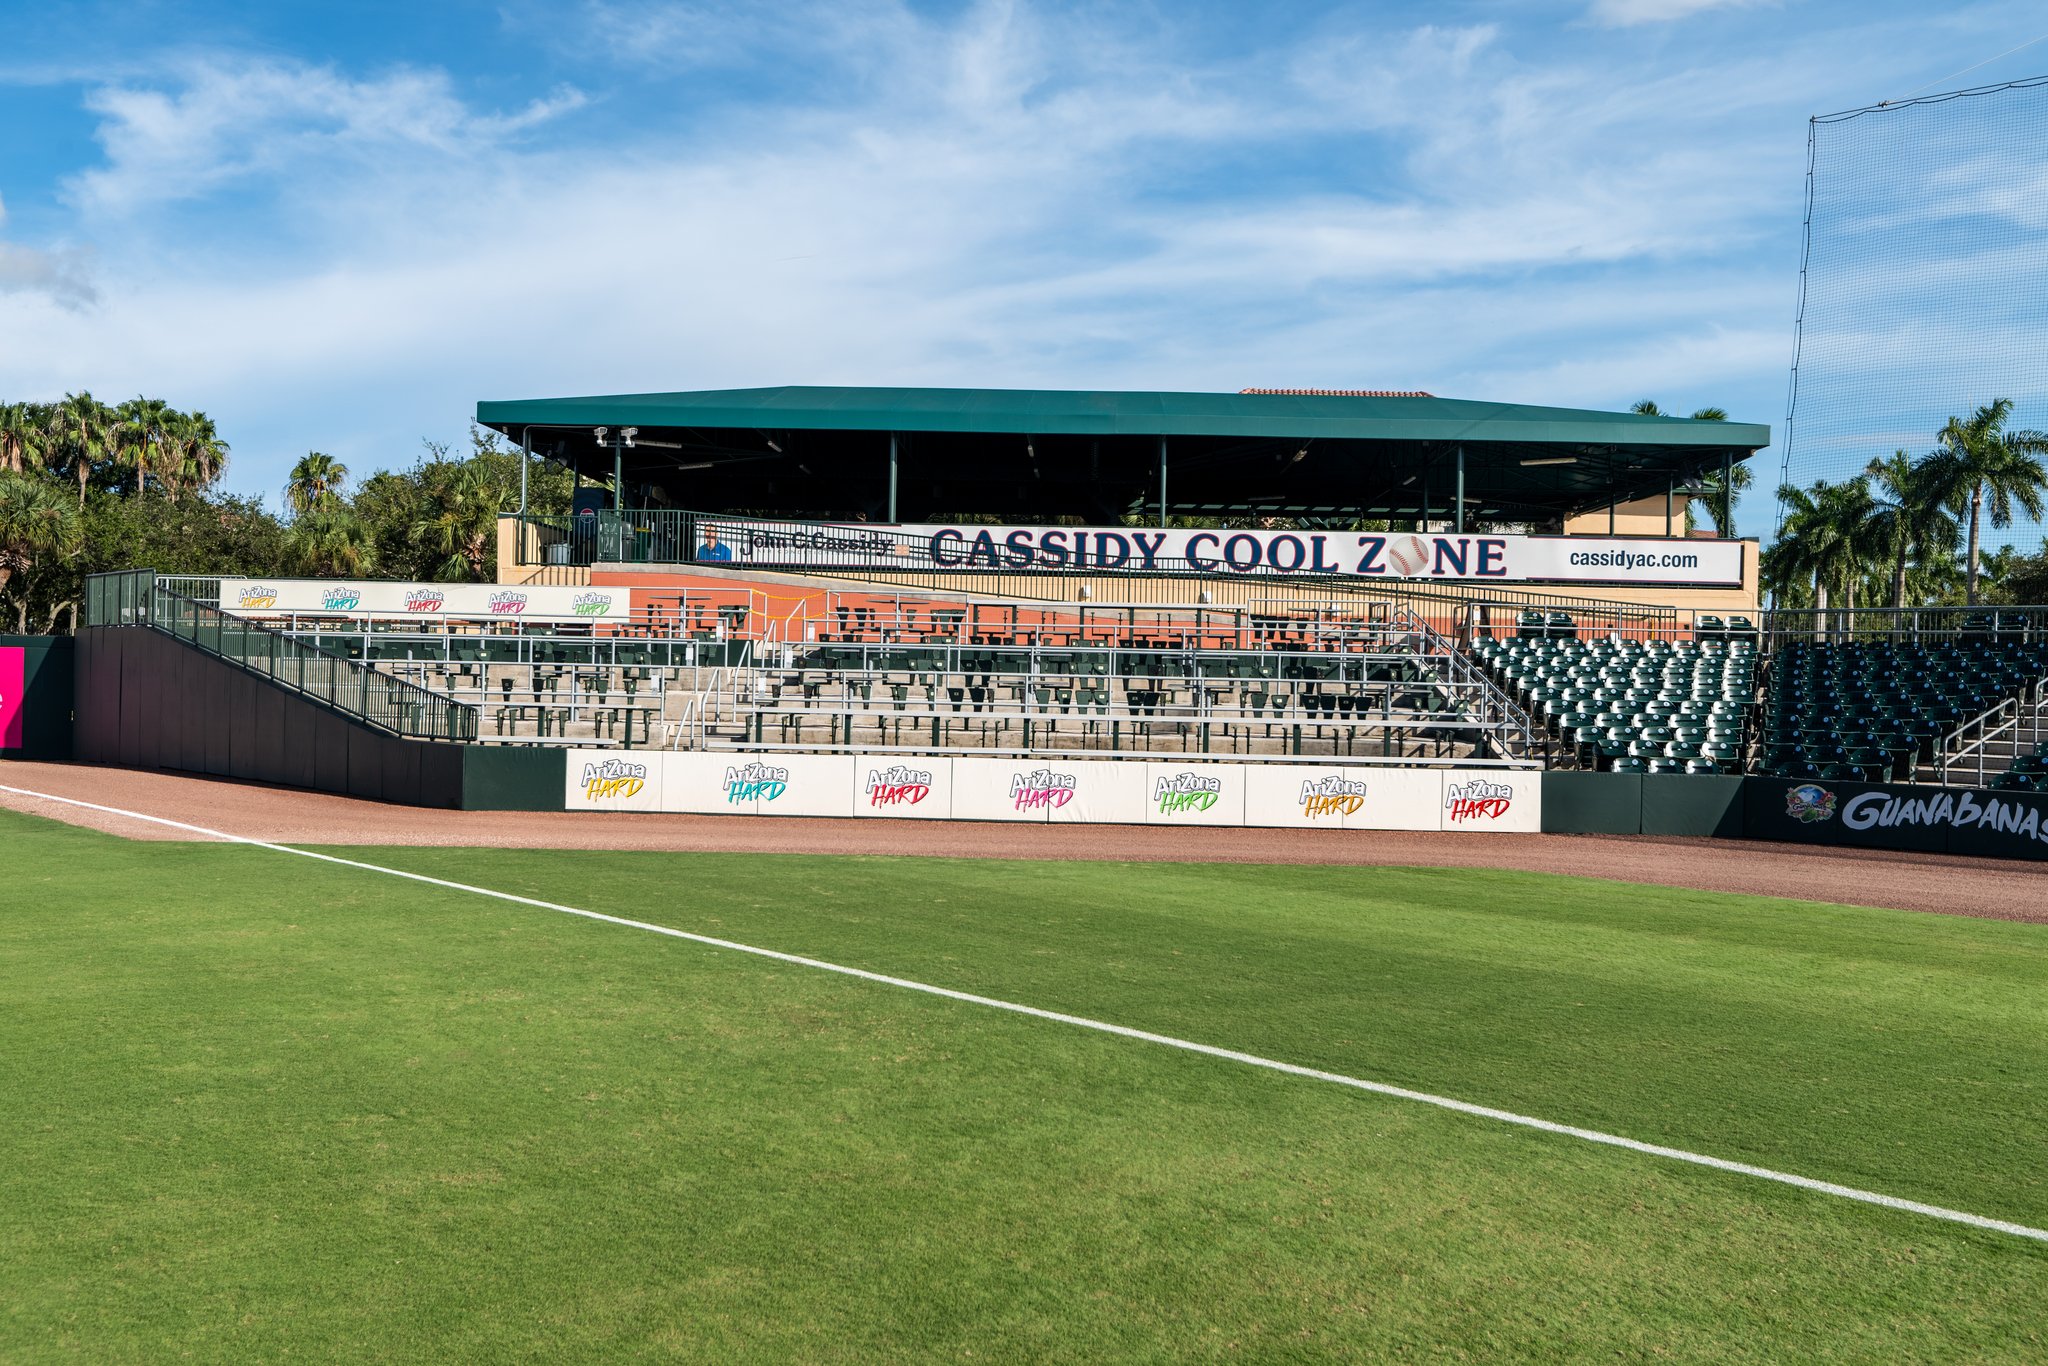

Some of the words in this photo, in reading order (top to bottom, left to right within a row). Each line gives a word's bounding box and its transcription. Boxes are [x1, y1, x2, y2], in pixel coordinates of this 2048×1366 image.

[930, 528, 1167, 569] CASSIDY
[1185, 533, 1339, 573] COOL
[1570, 550, 1698, 569] cassidyac.com
[241, 597, 277, 608] HARD
[325, 598, 359, 610] HARD
[408, 600, 442, 612] HARD
[491, 601, 526, 614] HARD
[576, 603, 610, 616] HARD
[581, 758, 647, 787] AriZona
[723, 762, 789, 791] AriZona
[865, 765, 932, 794] AriZona
[1009, 768, 1076, 798] AriZona
[586, 777, 644, 802] HARD
[728, 780, 787, 806] HARD
[871, 783, 929, 809] HARD
[1154, 772, 1221, 801] AriZona
[1299, 775, 1367, 805] AriZona
[1445, 779, 1513, 809] AriZona
[1015, 788, 1074, 813] HARD
[1160, 791, 1218, 817] HARD
[1305, 795, 1365, 820] HARD
[1451, 798, 1511, 824] HARD
